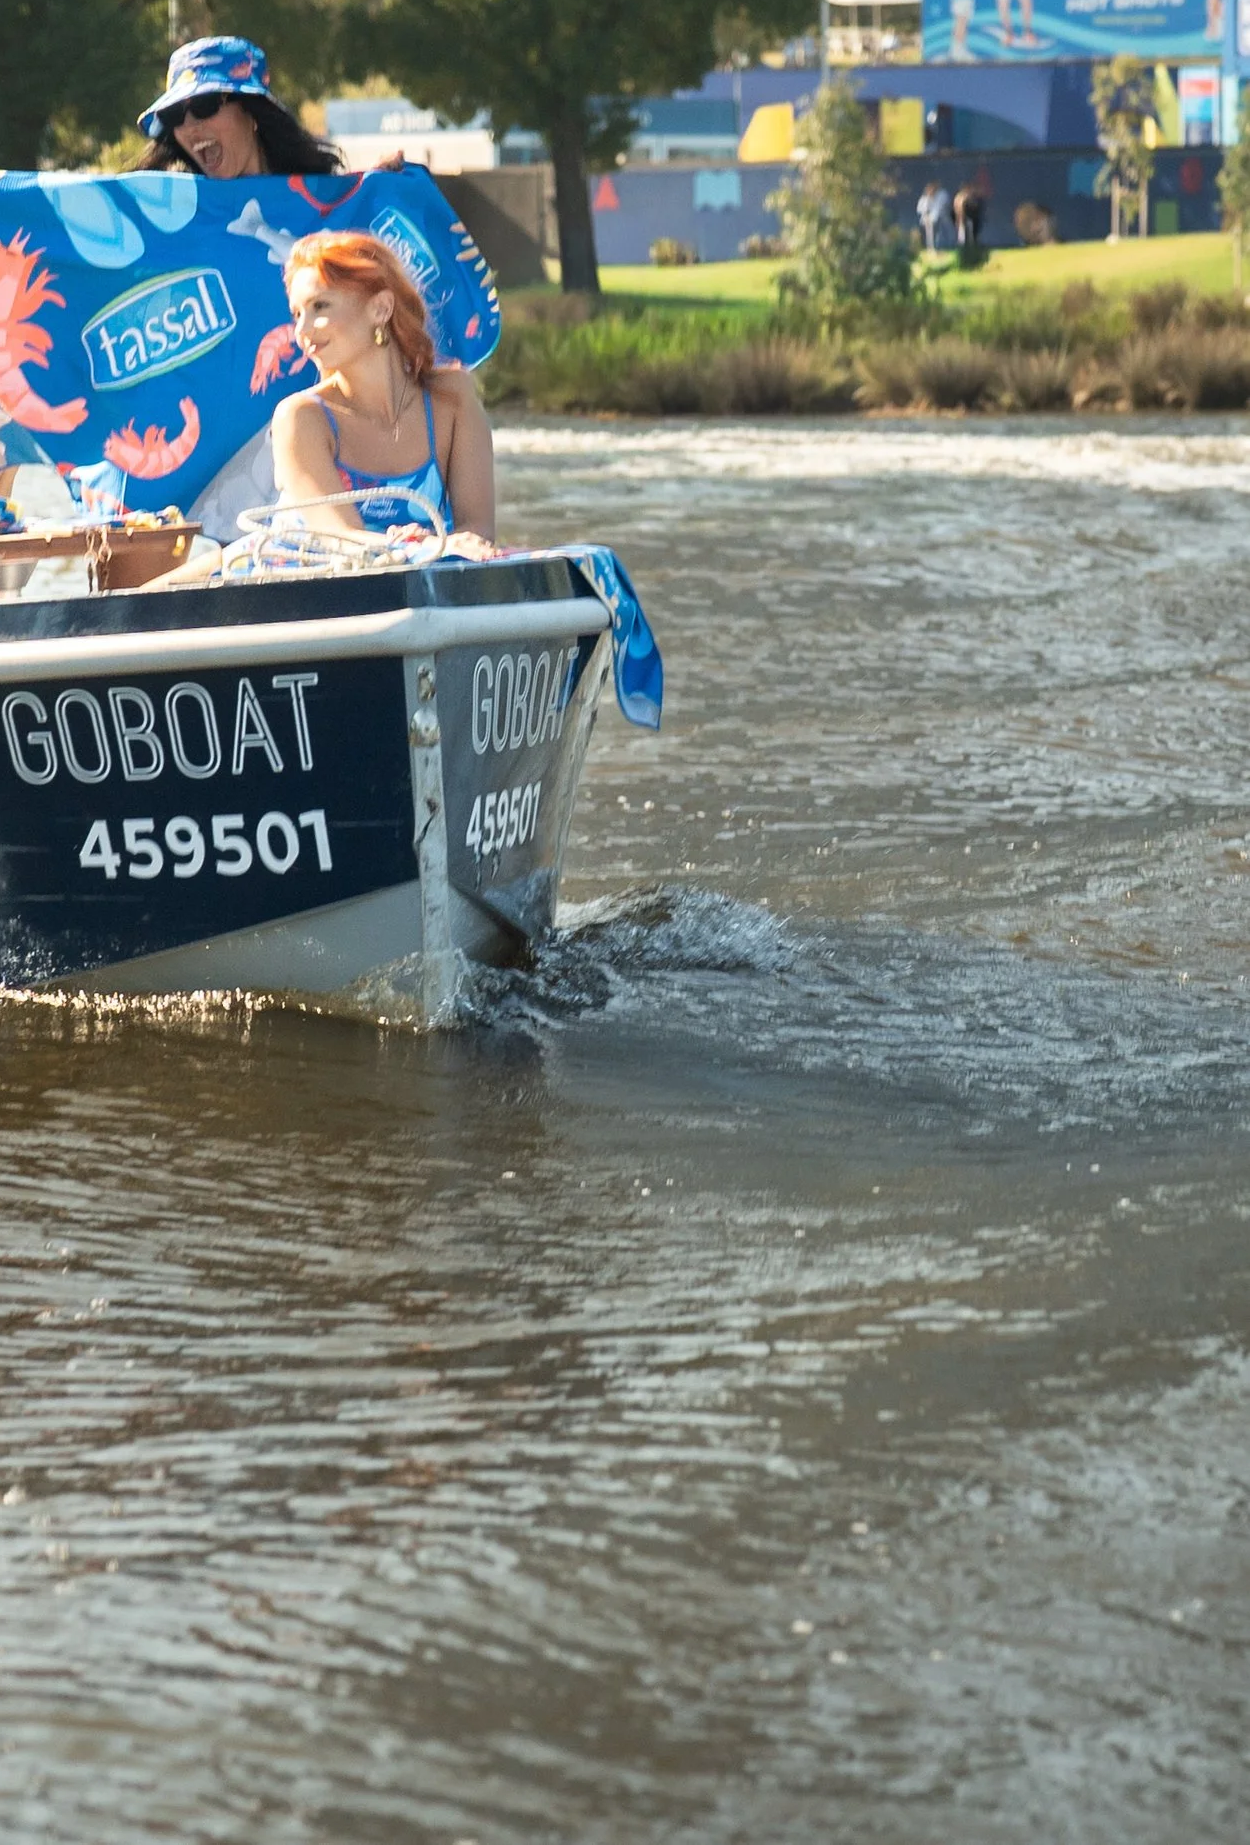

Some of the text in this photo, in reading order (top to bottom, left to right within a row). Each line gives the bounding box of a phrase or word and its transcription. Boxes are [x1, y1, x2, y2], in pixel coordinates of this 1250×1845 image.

[99, 276, 219, 378] tassal
[2, 672, 318, 785] GOBOAT
[471, 646, 579, 755] GOBOAT
[79, 809, 333, 880] 459501
[465, 780, 542, 855] 459501
